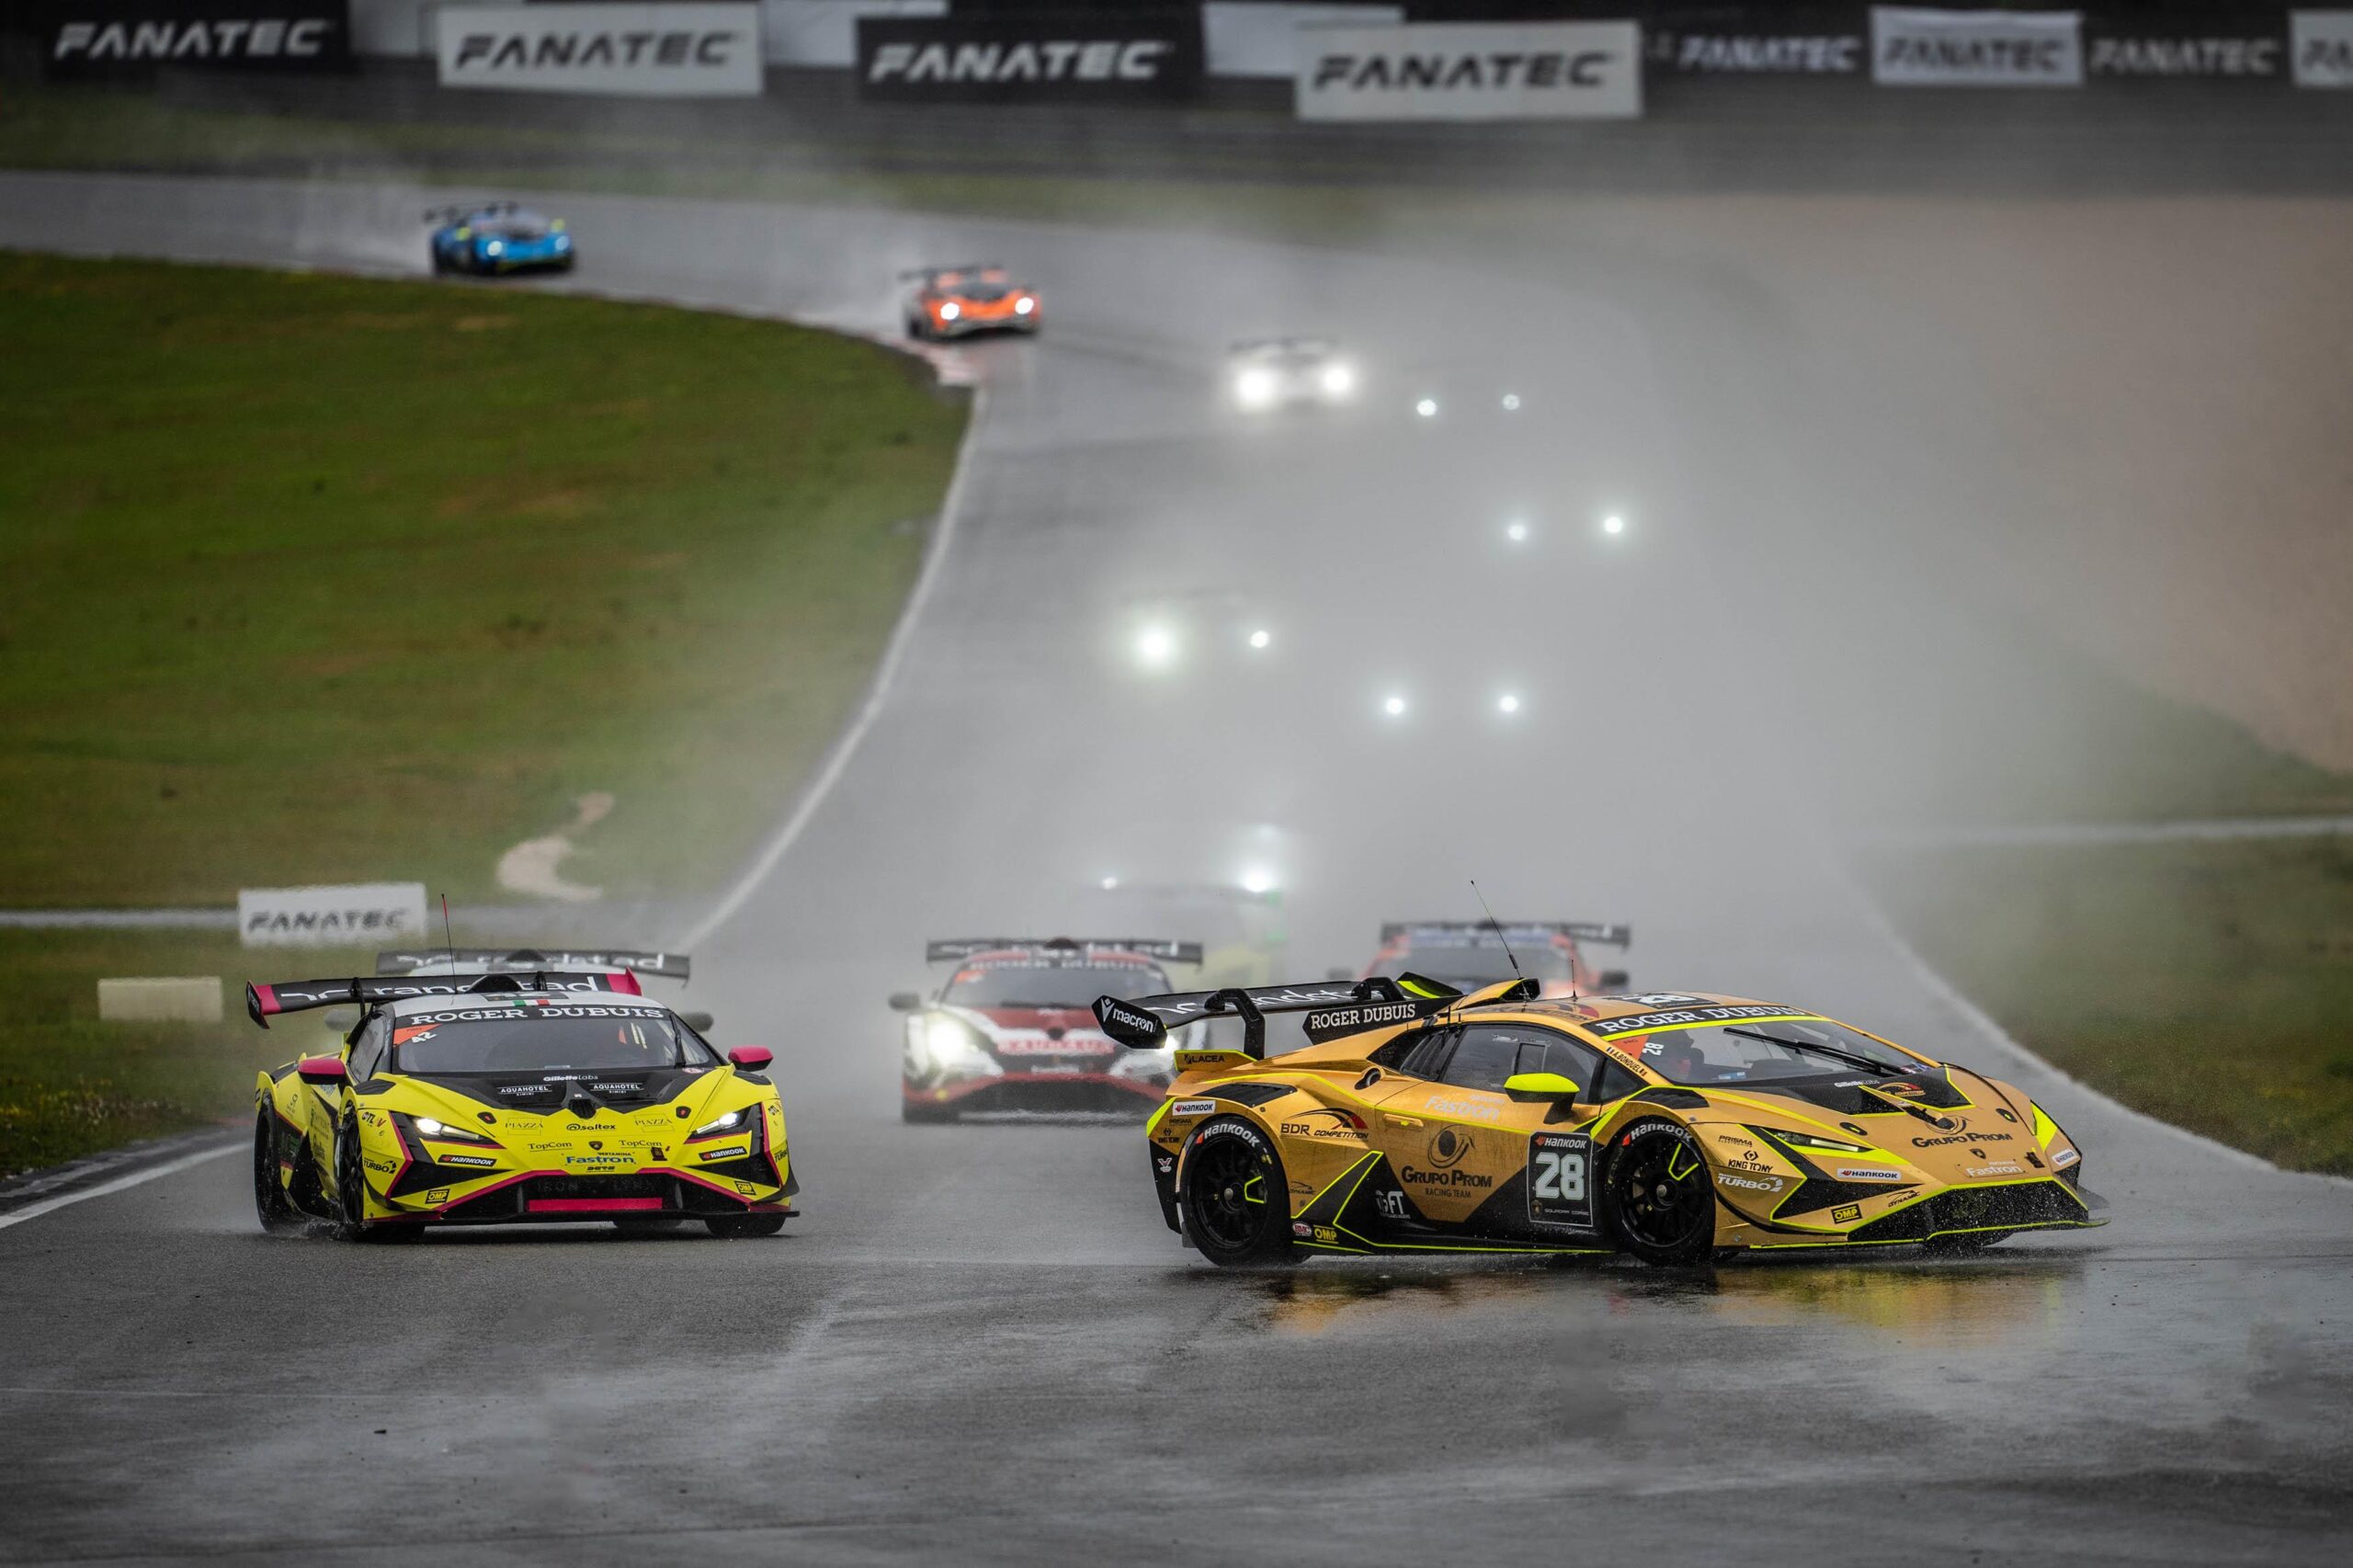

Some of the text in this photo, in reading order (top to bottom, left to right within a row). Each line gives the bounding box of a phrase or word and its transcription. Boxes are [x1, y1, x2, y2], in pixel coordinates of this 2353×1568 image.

[53, 19, 328, 60] FANATEC
[456, 32, 737, 69] FANATEC
[870, 40, 1167, 83] FANATEC
[1313, 52, 1611, 89] FANATEC
[248, 908, 408, 932] FANATEC
[411, 1006, 665, 1025] ROGER DUBUIS
[1112, 1007, 1154, 1033] macron
[1311, 1004, 1416, 1029] ROGER DUBUIS
[1596, 1011, 1704, 1032] ROGER
[1701, 1006, 1807, 1019] DUBUIS
[1642, 1042, 1665, 1056] 28
[1426, 1095, 1500, 1120] Fastron
[1280, 1122, 1310, 1136] BDR
[1313, 1130, 1369, 1139] COMPETITION
[528, 1142, 573, 1150] TopCom
[1719, 1135, 1753, 1147] PRISMA
[1911, 1132, 2013, 1148] GRUPO PROM
[565, 1155, 635, 1164] Fastron
[1728, 1159, 1773, 1173] KING TONY
[1402, 1165, 1493, 1187] GRUPO PROM
[1535, 1151, 1585, 1200] 28
[1965, 1165, 2022, 1177] Fastron
[428, 1192, 448, 1201] OMP
[1425, 1187, 1472, 1199] RACING TEAM
[1834, 1209, 1859, 1220] OMP
[1314, 1228, 1337, 1241] OMP
